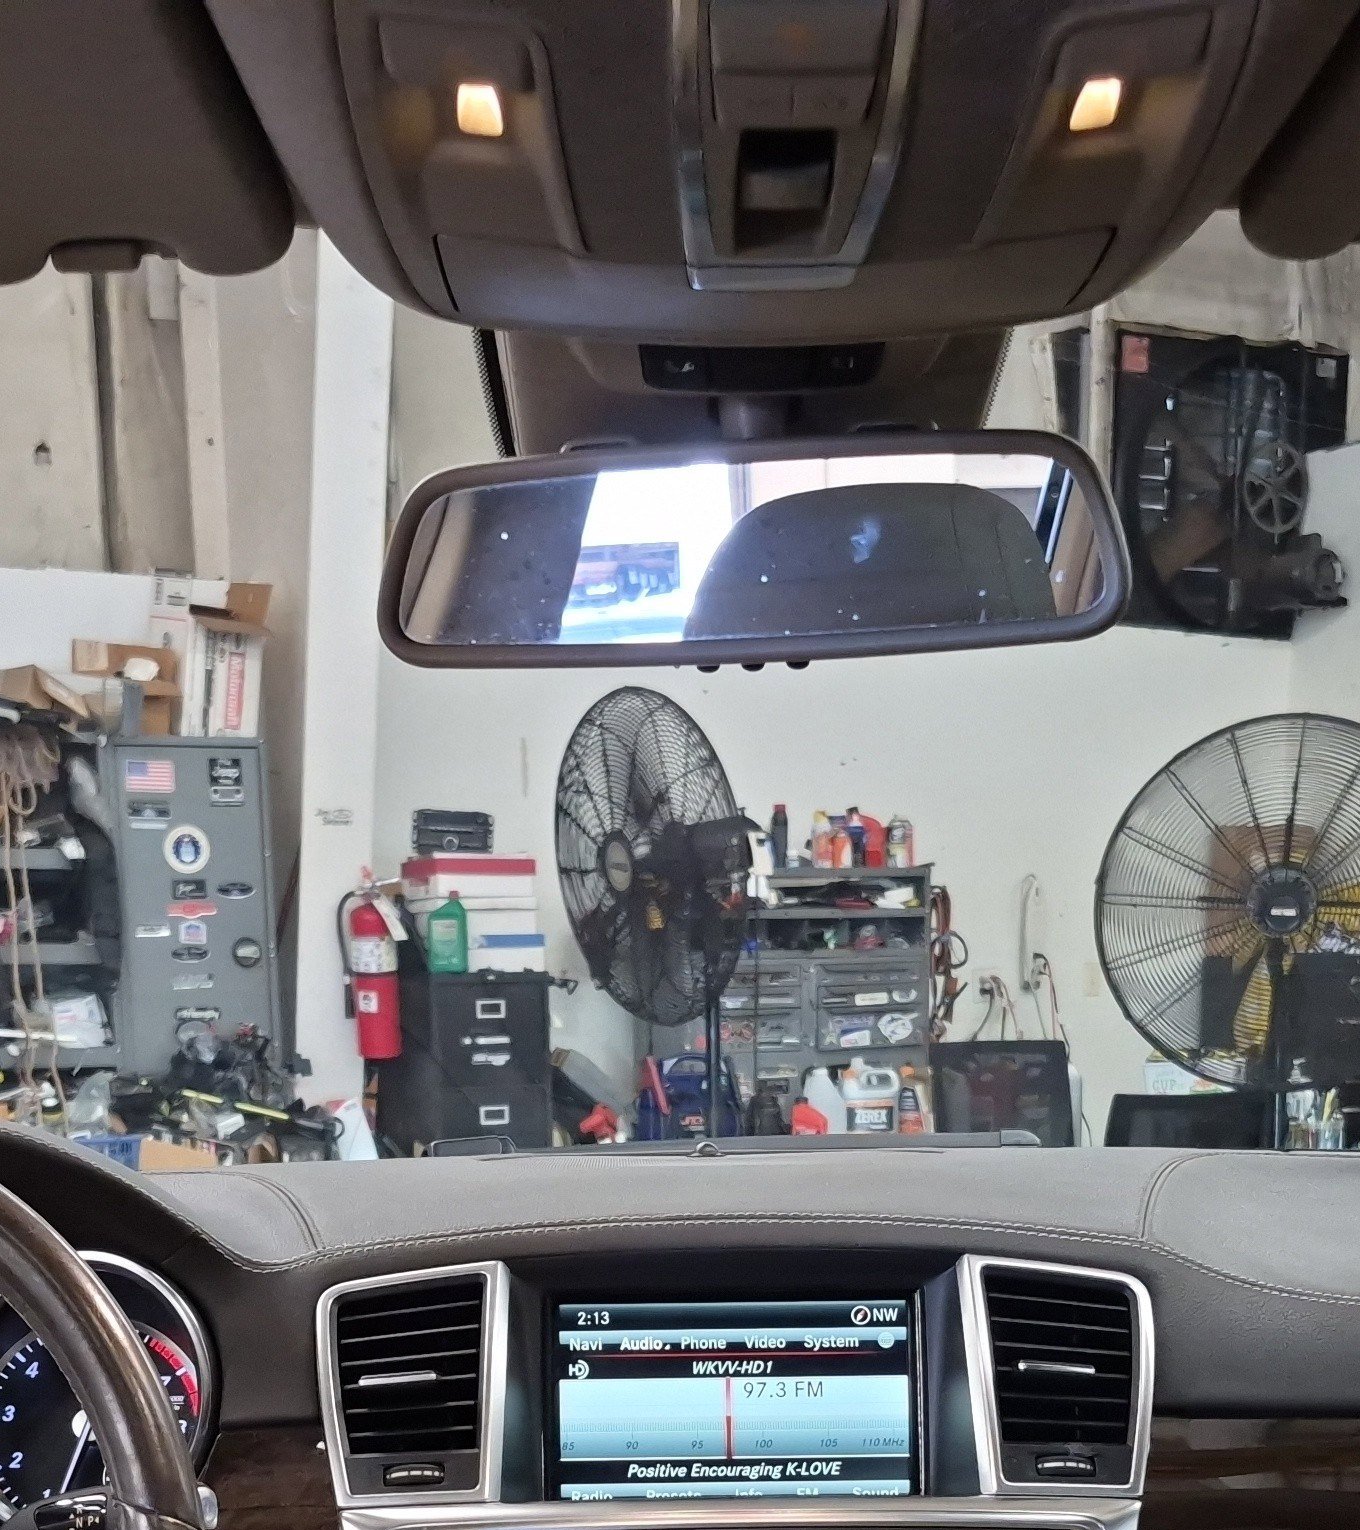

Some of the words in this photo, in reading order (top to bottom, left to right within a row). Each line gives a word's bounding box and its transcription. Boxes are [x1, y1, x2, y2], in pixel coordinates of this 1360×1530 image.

[577, 1311, 610, 1325] 2:13
[872, 1308, 898, 1322] NW
[569, 1338, 602, 1350] Navi
[620, 1337, 663, 1350] Audio
[681, 1336, 727, 1349] Phone
[745, 1335, 786, 1348] Video
[804, 1335, 859, 1351] System
[25, 1362, 39, 1378] 4
[693, 1361, 773, 1375] WKVV-HD1
[744, 1382, 787, 1398] 97.3
[795, 1381, 823, 1397] FM
[2, 1405, 15, 1421] 3
[562, 1441, 575, 1451] 85
[626, 1440, 639, 1450] 90
[691, 1440, 704, 1450] 95
[755, 1439, 773, 1448] 100
[820, 1438, 838, 1447] 105
[862, 1438, 880, 1447] 110
[883, 1438, 905, 1447] MHz
[9, 1452, 23, 1468] 2
[628, 1463, 688, 1478] Positive
[690, 1463, 783, 1480] Encouraging
[786, 1461, 842, 1476] K-LOVE
[76, 1516, 83, 1528] N
[88, 1515, 94, 1526] P
